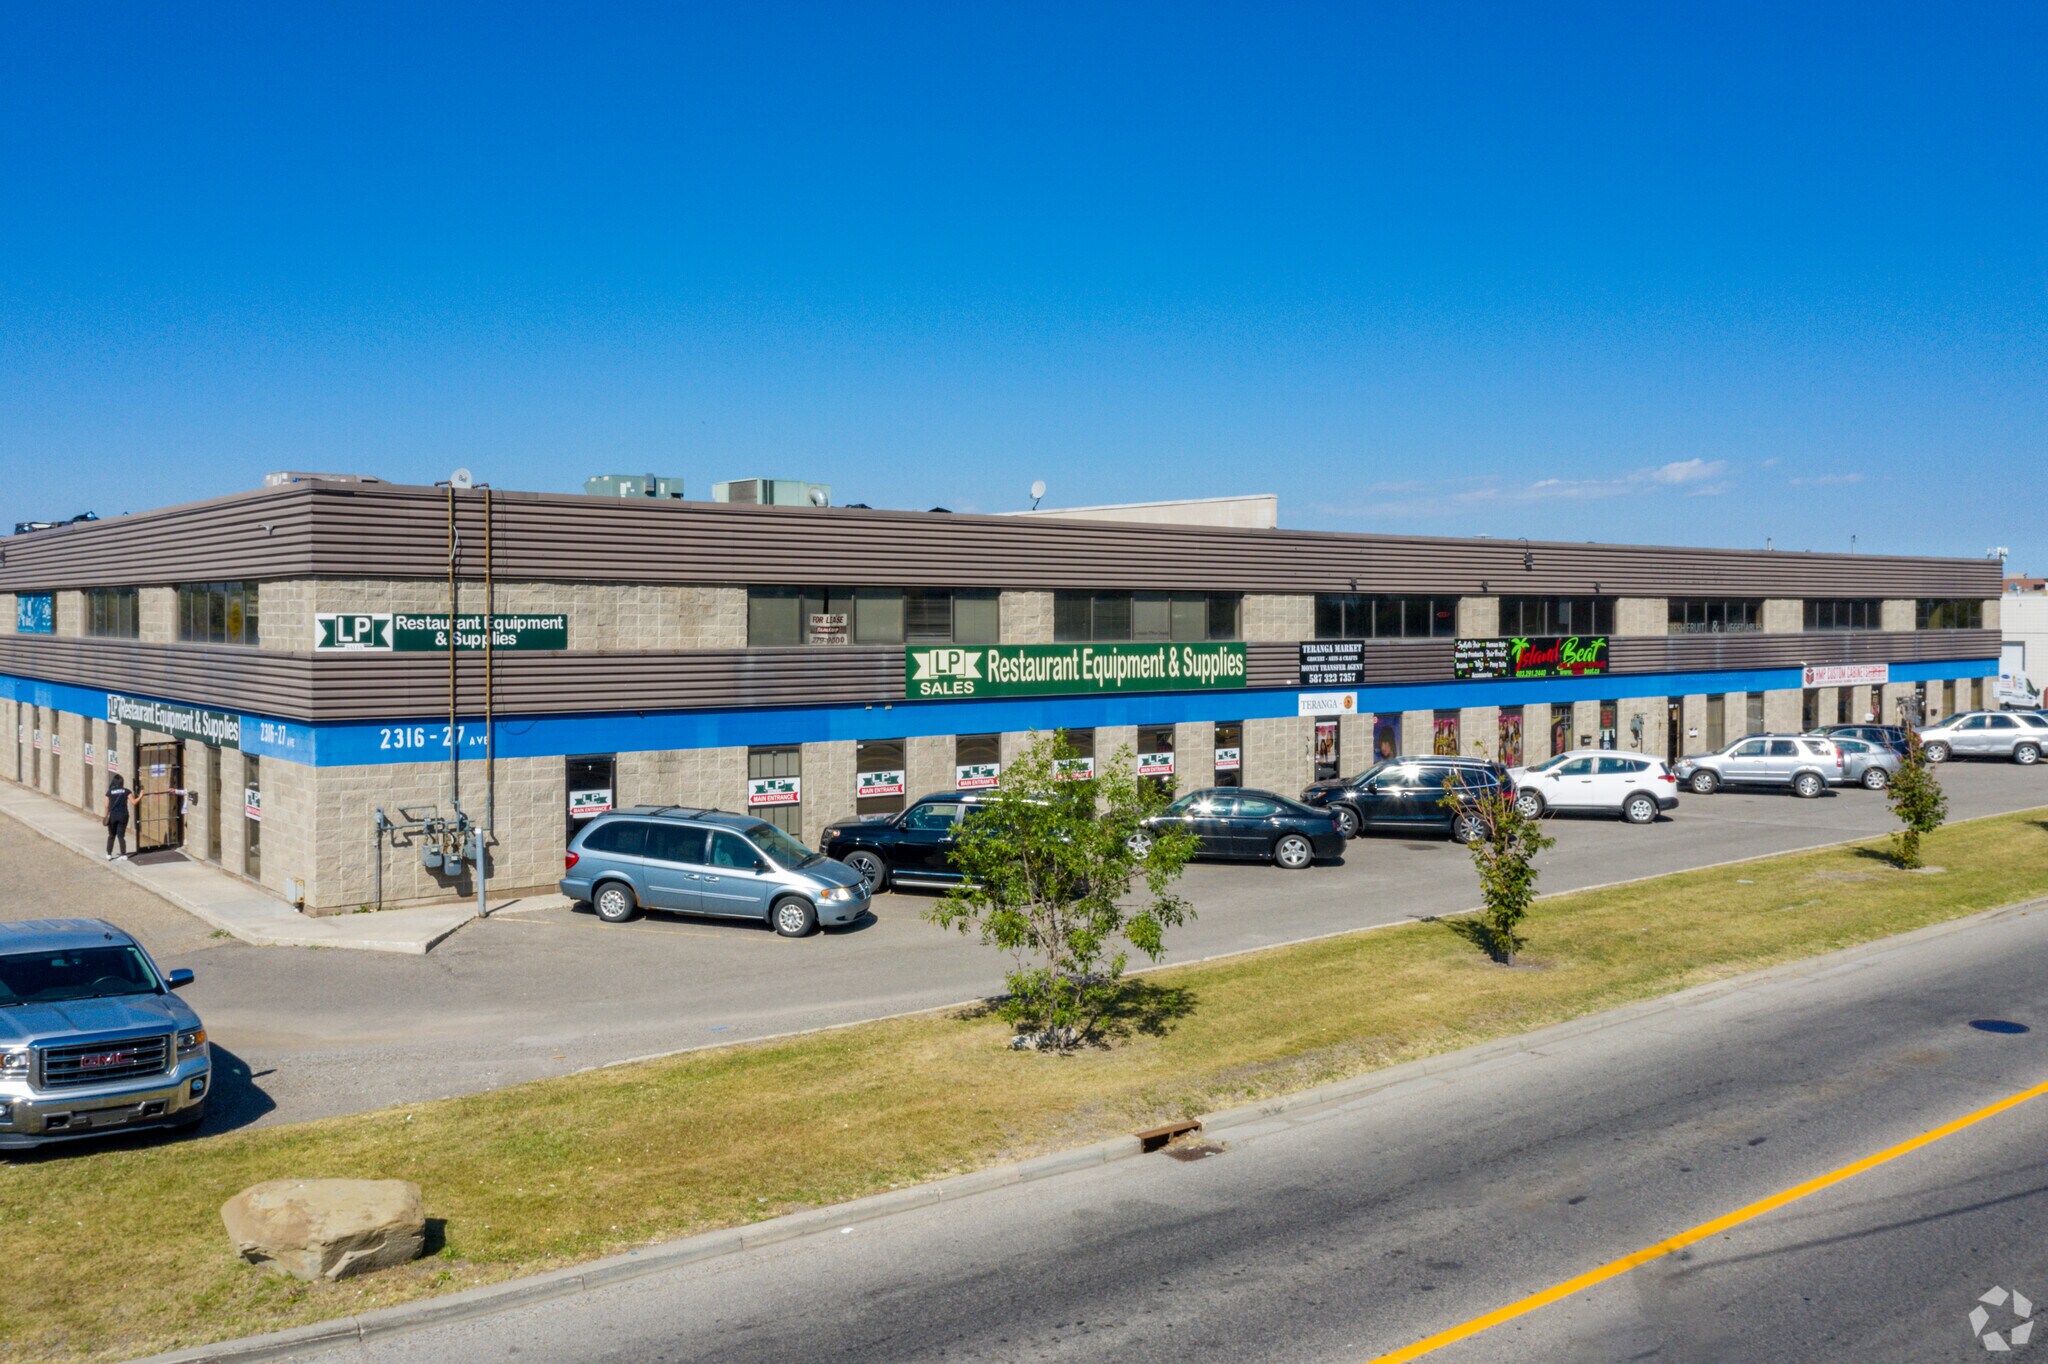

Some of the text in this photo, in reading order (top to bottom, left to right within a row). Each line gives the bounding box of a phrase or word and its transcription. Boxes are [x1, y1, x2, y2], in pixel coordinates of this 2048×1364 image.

[484, 615, 563, 633] Equipment
[812, 615, 844, 624] FOR LEASE
[338, 616, 371, 642] LP
[1712, 620, 1719, 634] &
[435, 631, 517, 648] & Supplies
[1302, 644, 1363, 653] TERANGA MARKET
[1516, 637, 1606, 672] Island Beat
[935, 651, 960, 674] LP
[988, 646, 1243, 687] Restaurant Equipment & Supplies
[1301, 664, 1319, 672] MONEY
[1347, 663, 1364, 671] AGENT
[1309, 672, 1357, 683] 587 323 7357
[920, 681, 974, 695] SALES
[1301, 699, 1338, 710] TERANGA
[121, 697, 239, 745] Restaurant Equipment & Supplies
[970, 765, 986, 775] LP
[872, 772, 890, 783] LP
[764, 780, 784, 791] LP
[582, 793, 599, 803] LP
[753, 792, 794, 802] MAIN ENTRANCE
[81, 1052, 134, 1067] GMC
